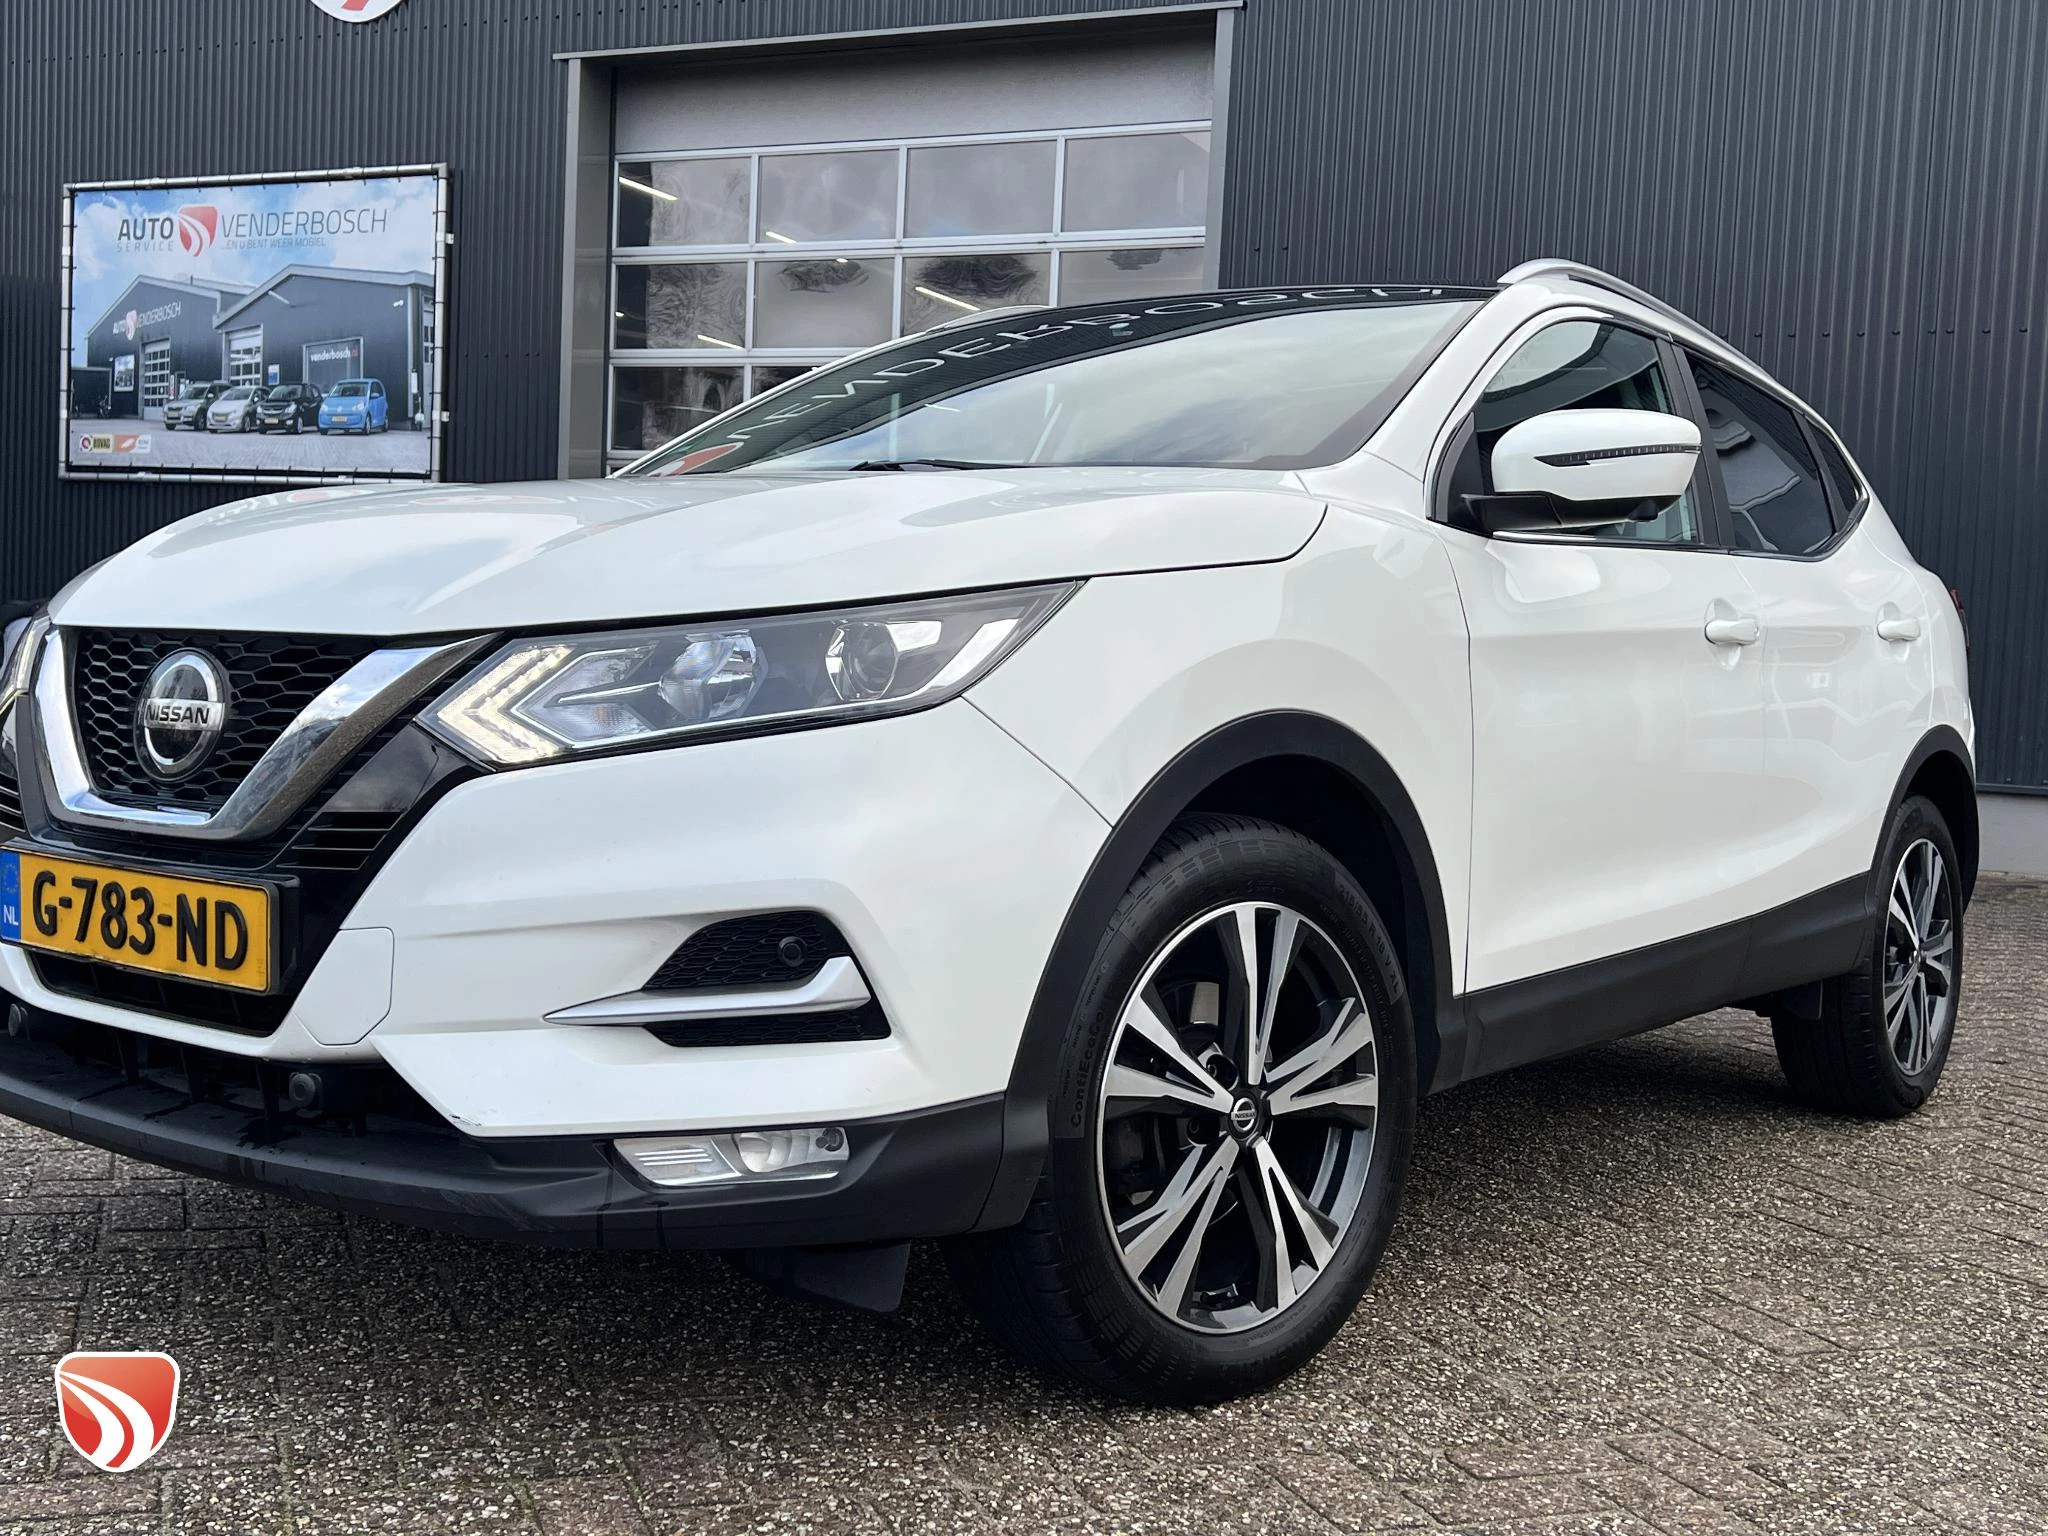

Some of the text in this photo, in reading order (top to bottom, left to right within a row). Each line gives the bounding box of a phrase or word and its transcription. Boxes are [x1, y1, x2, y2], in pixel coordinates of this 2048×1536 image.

[118, 208, 388, 241] AUTO VENDERBOSCH
[116, 240, 174, 253] SERVICE
[239, 239, 246, 250] U
[247, 239, 268, 249] BENT
[269, 238, 294, 249] WEER
[145, 704, 210, 725] NISSAN
[3, 903, 19, 927] NL
[32, 870, 248, 971] G-783-ND
